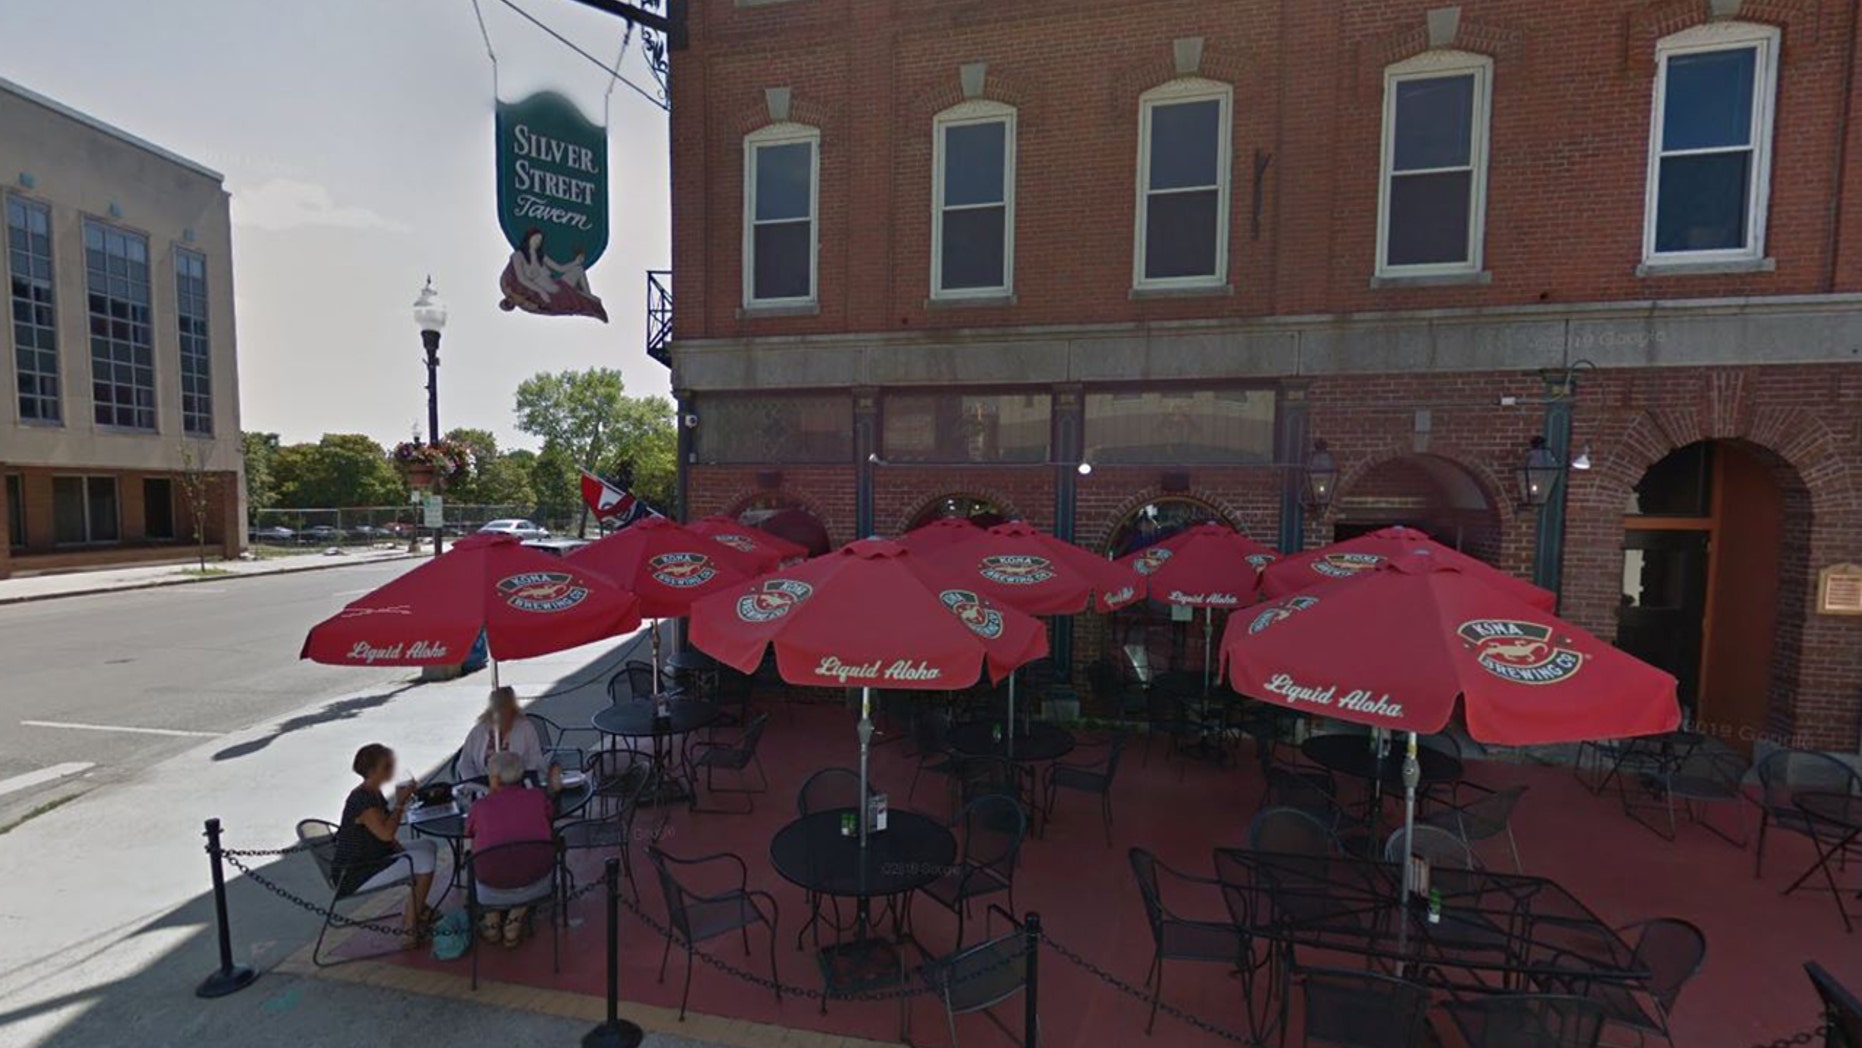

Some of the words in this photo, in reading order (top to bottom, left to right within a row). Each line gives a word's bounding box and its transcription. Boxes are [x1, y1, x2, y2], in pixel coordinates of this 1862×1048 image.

[513, 124, 599, 174] SILVER
[514, 159, 595, 205] STREET
[513, 194, 592, 230] Tavern
[511, 573, 553, 585] KONA
[514, 595, 574, 610] BREWING
[347, 640, 402, 664] Liquid
[405, 641, 448, 660] Aloha
[814, 656, 882, 684] Liquid
[883, 659, 940, 681] Aloha
[1484, 656, 1564, 681] BREWING
[1263, 673, 1337, 703] Liquid
[1337, 689, 1403, 717] Aloha
